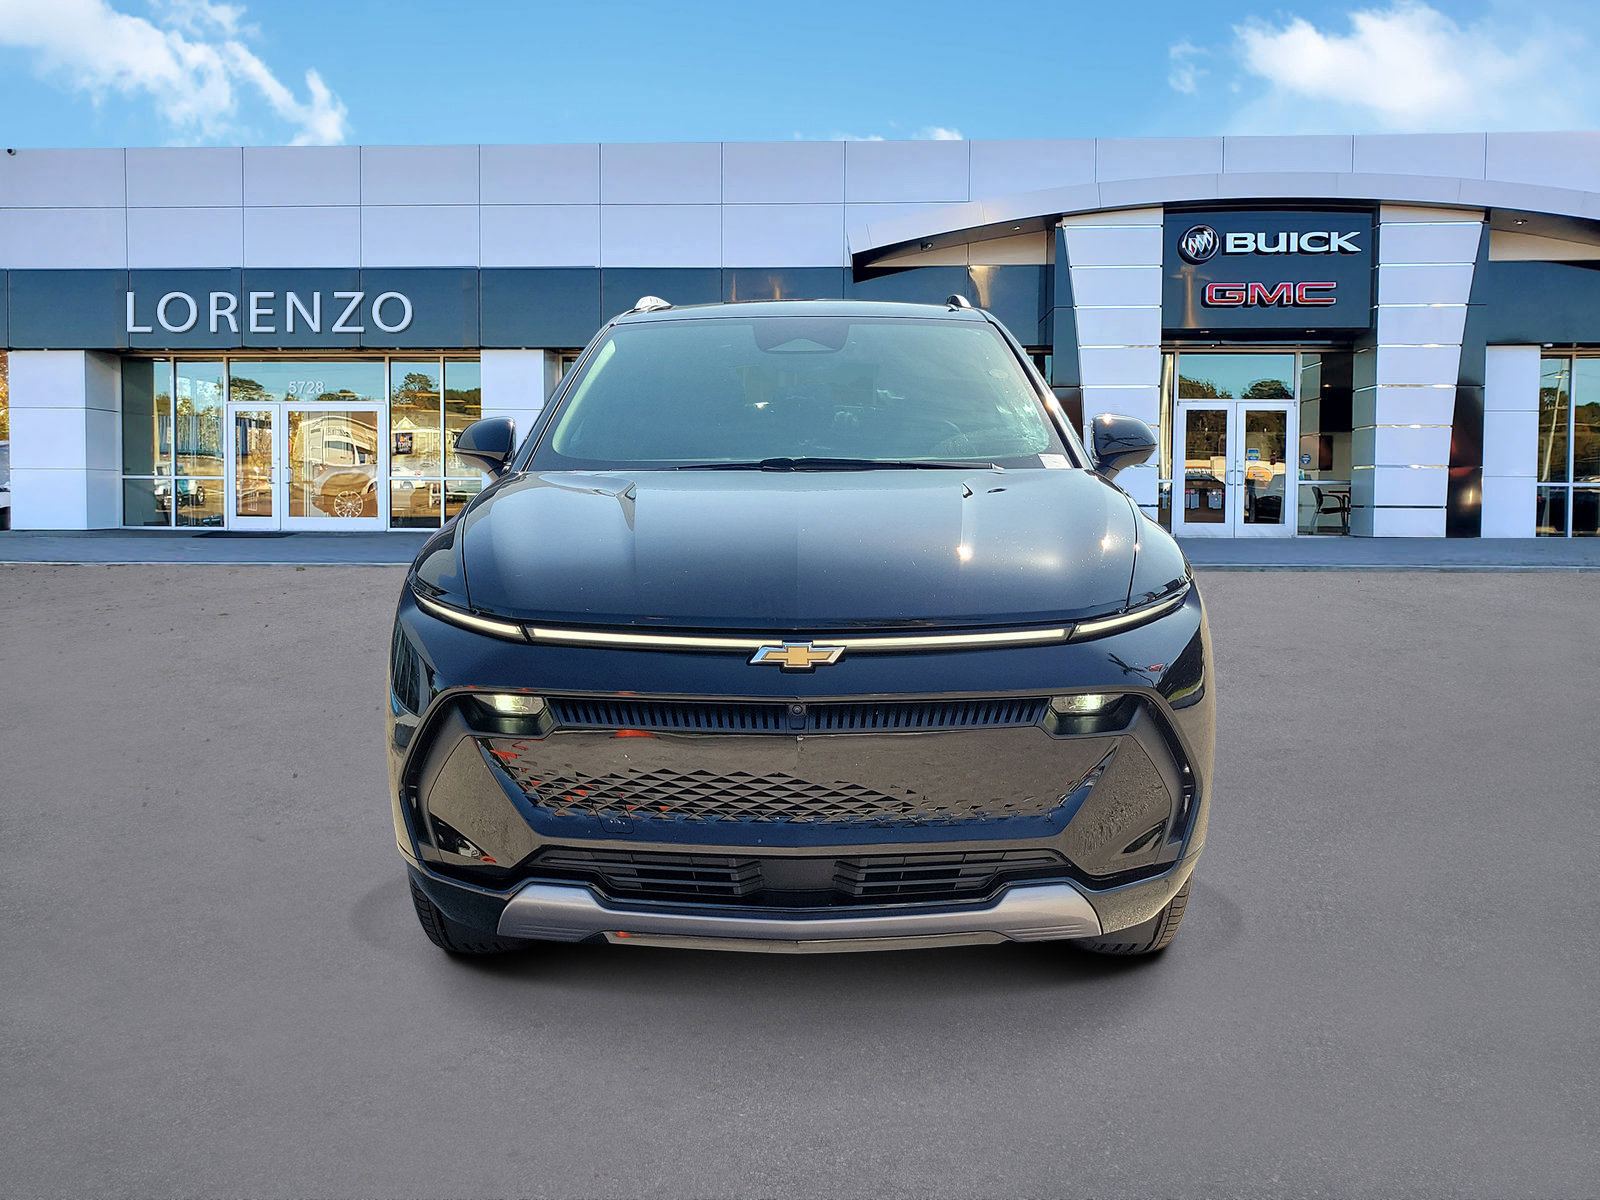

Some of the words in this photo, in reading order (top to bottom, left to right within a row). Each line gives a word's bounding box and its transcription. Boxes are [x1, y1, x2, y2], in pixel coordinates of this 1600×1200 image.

[1224, 231, 1362, 254] BUICK
[1204, 282, 1337, 306] GMC
[126, 291, 414, 333] LORENZO
[288, 380, 325, 395] 5728
